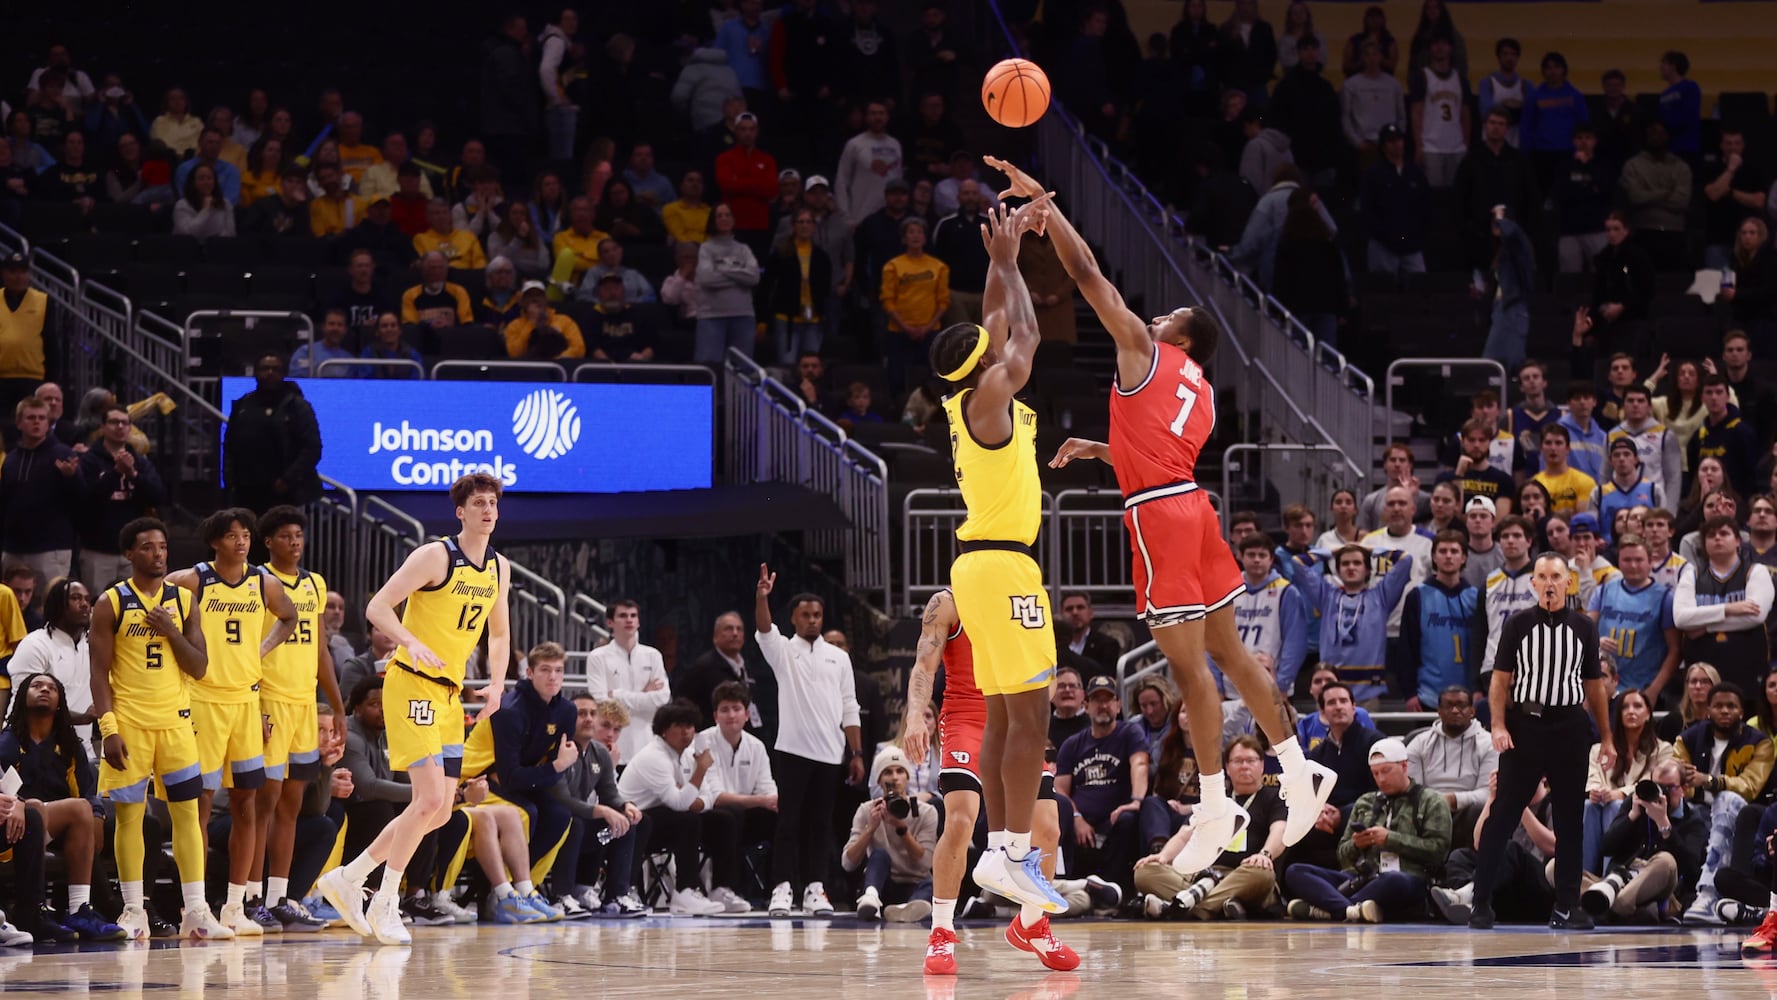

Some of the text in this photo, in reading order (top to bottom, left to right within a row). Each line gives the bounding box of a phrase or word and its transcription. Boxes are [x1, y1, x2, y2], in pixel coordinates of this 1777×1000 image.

[1441, 104, 1453, 121] 3
[1170, 382, 1197, 438] 7
[368, 420, 493, 454] Johnson
[451, 580, 495, 600] Marquette
[205, 598, 260, 616] Marquette
[457, 602, 484, 632] 12
[1009, 595, 1046, 628] MU
[225, 618, 242, 644] 9
[1238, 625, 1263, 646] 77
[146, 643, 164, 670] 5
[1453, 633, 1464, 664] 1
[408, 700, 436, 726] MU
[1725, 744, 1756, 777] M
